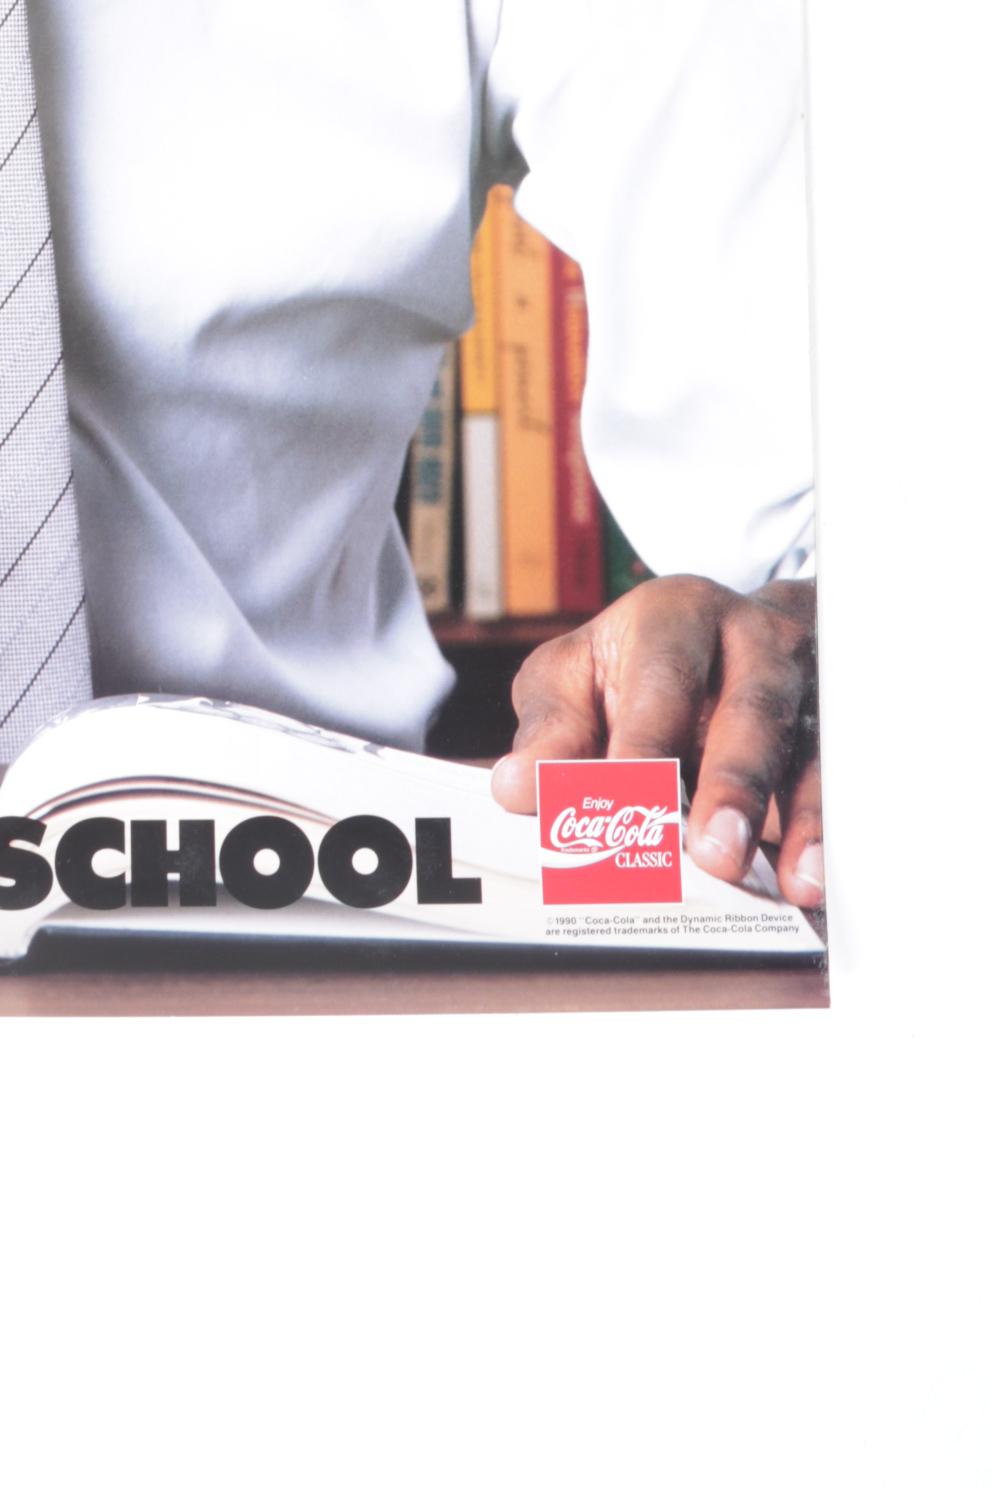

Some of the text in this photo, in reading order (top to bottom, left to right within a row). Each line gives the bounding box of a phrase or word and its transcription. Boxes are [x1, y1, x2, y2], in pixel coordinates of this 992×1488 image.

[582, 797, 615, 811] Enjoy
[550, 806, 668, 849] Coca-Cola
[615, 851, 673, 868] CLASSIC
[642, 914, 660, 925] and
[662, 914, 678, 924] the
[680, 913, 722, 925] Dynamic
[725, 913, 759, 923] Ribbon
[761, 912, 793, 922] Device
[545, 923, 800, 937] are registered trademarks of The Coca-Cola Company
